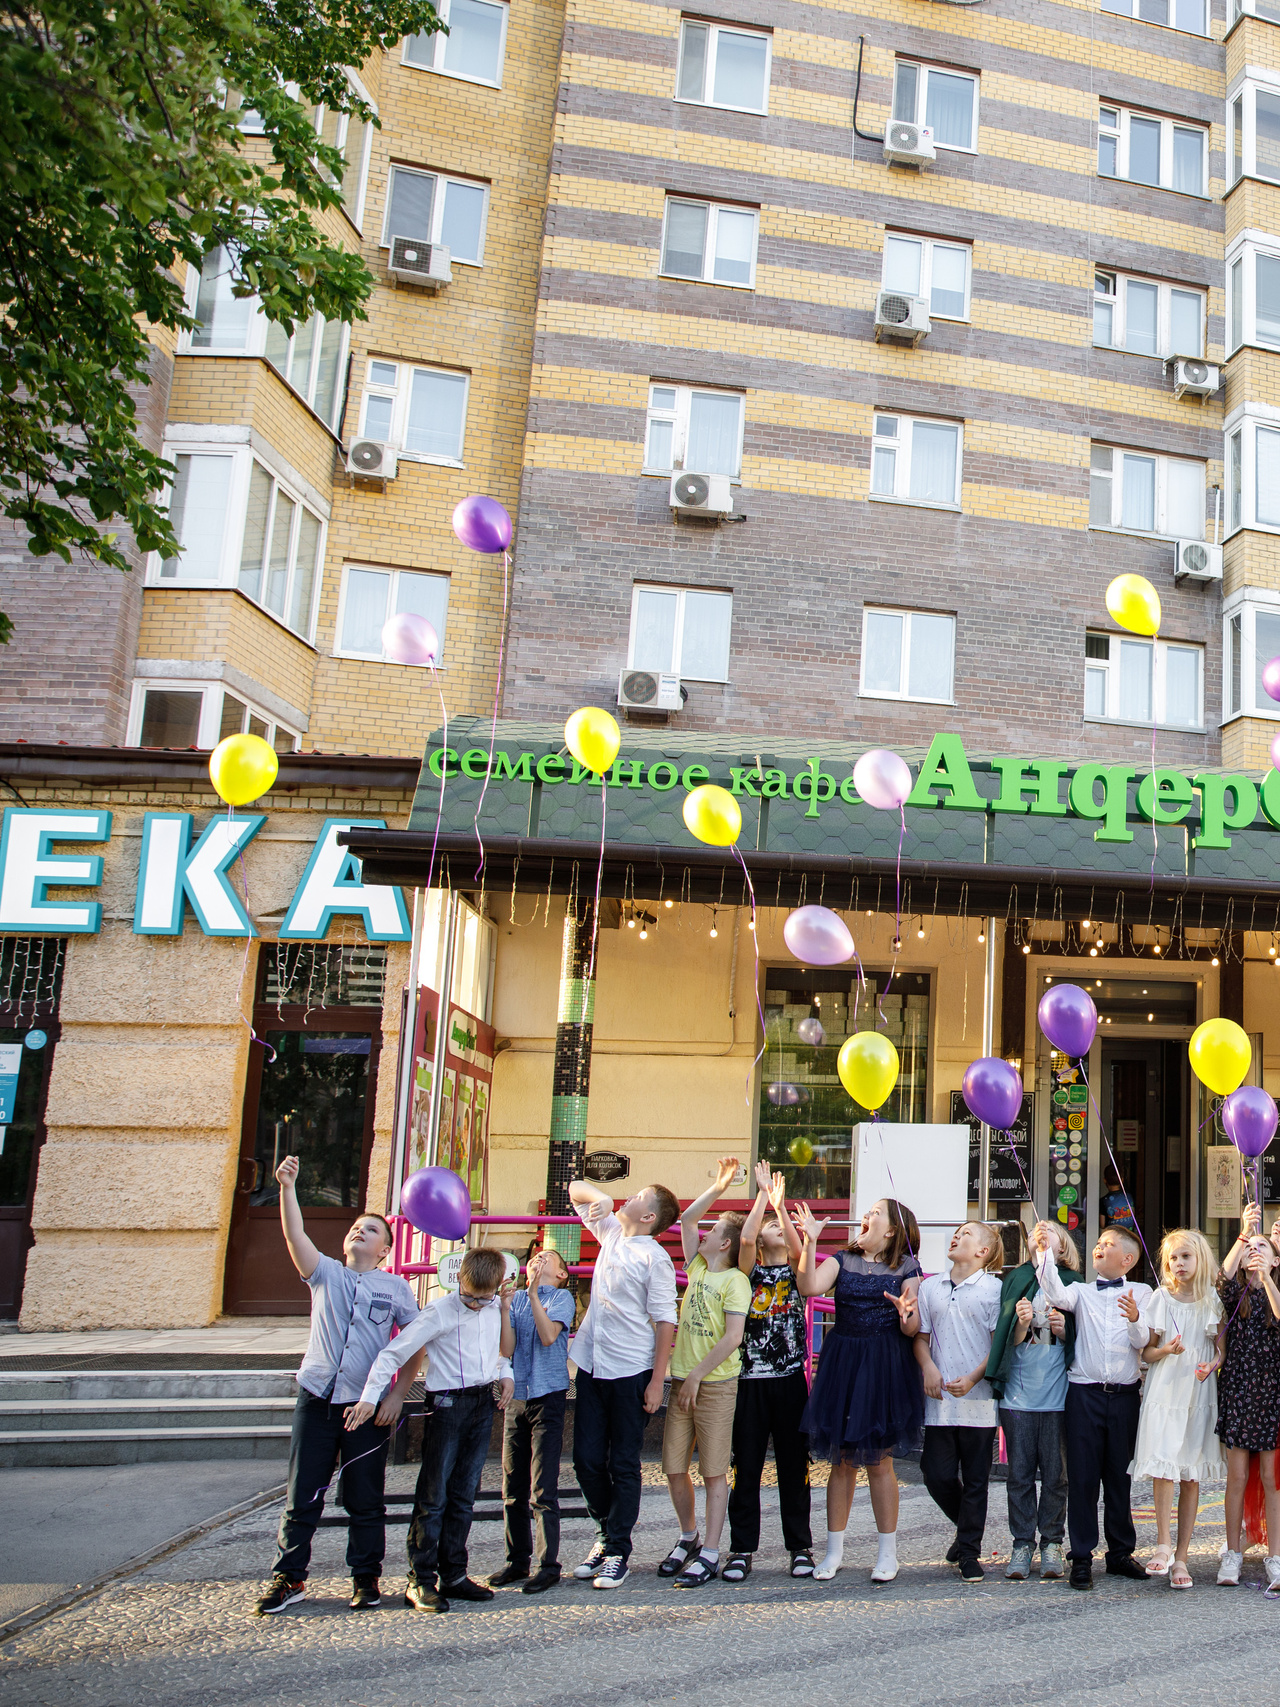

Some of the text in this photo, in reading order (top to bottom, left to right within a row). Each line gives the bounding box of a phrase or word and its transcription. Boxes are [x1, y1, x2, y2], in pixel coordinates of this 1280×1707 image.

[729, 757, 864, 818] кафе
[0, 807, 412, 942] ЕКА
[448, 1258, 462, 1269] ПАР
[372, 1292, 393, 1301] UNIQUE
